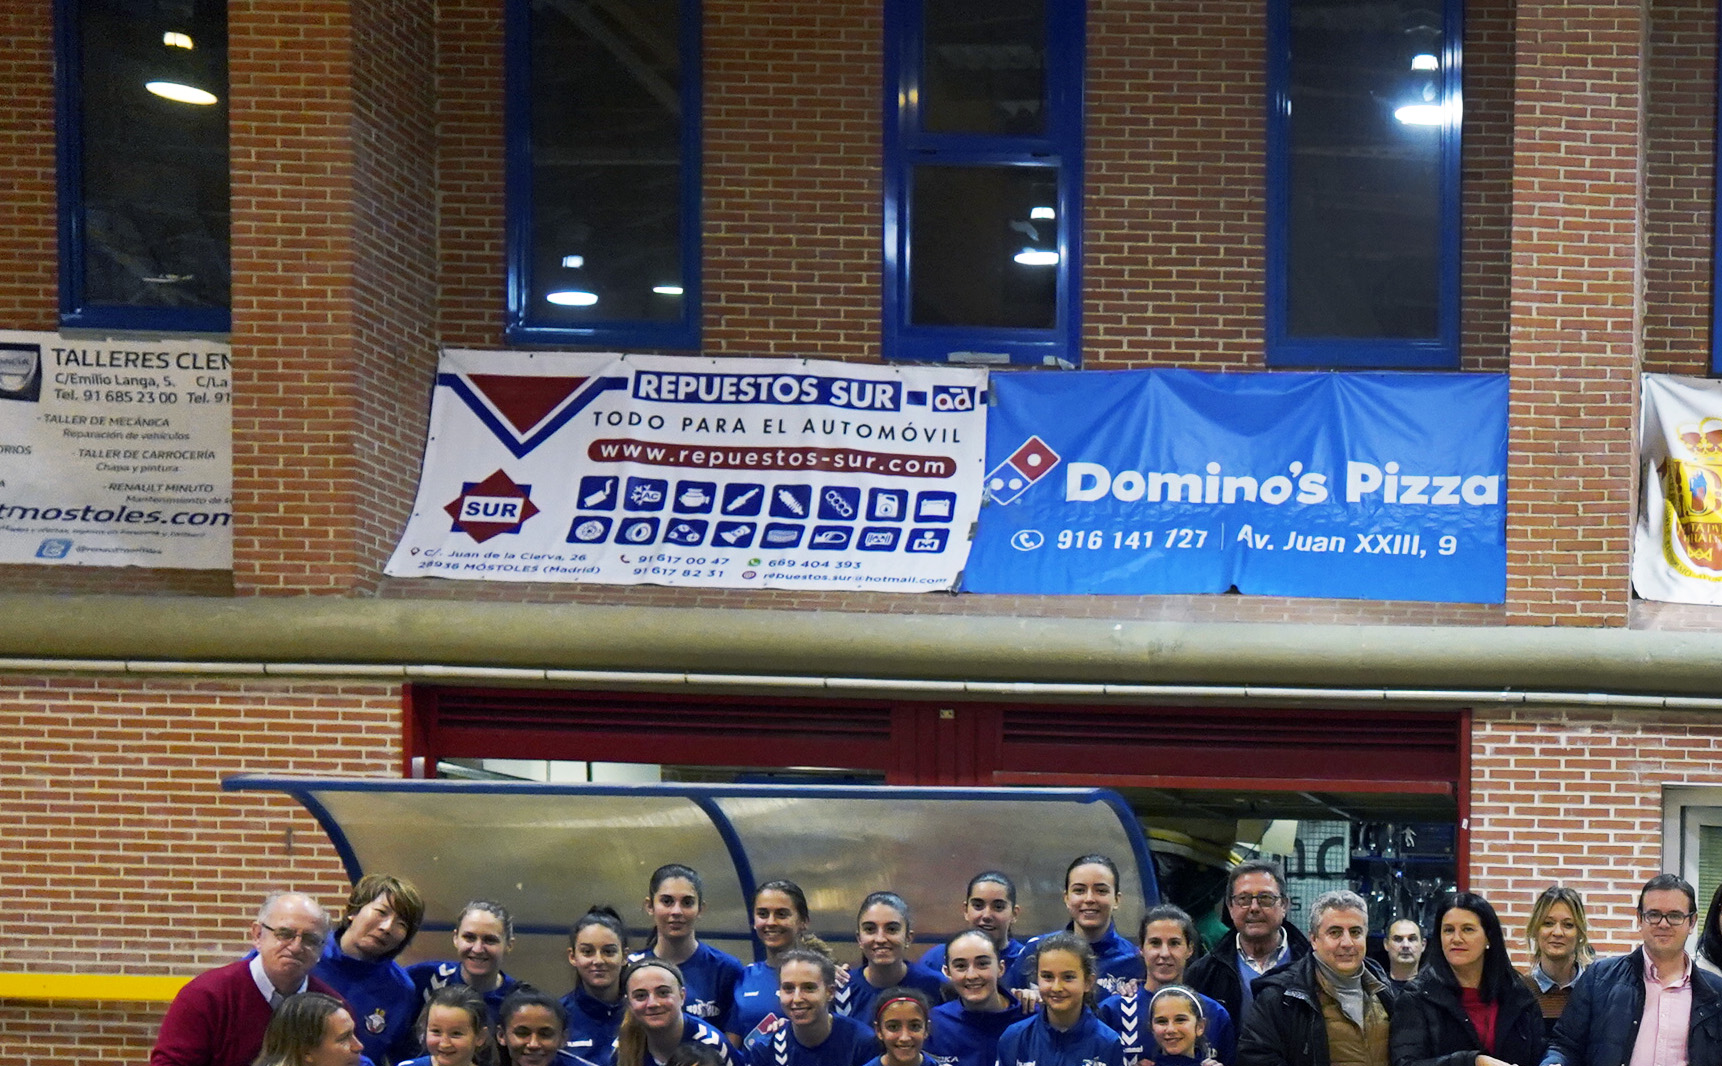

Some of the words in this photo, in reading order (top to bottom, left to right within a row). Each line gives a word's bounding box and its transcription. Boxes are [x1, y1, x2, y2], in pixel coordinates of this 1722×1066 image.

[51, 348, 169, 370] TALLERES
[84, 389, 101, 402] 91
[105, 391, 133, 403] 685
[136, 391, 155, 404] 23
[159, 392, 178, 404] 00
[638, 374, 819, 404] REPUESTOS
[829, 380, 897, 409] SUR
[44, 414, 87, 425] TALLER
[90, 415, 105, 426] DE
[109, 415, 170, 427] MECÁNICA
[594, 411, 665, 431] TODO
[682, 417, 746, 434] PARA
[763, 418, 786, 435] EL
[802, 418, 961, 444] AUTOMÓVIL
[78, 448, 120, 459] TALLER
[600, 441, 946, 476] www.repuestos-sur.com
[1065, 461, 1329, 505] Domino's
[1345, 460, 1499, 506] Pizza
[465, 501, 517, 518] SUR
[1057, 530, 1102, 551] 916
[1113, 531, 1153, 551] 141
[1165, 529, 1208, 549] 727
[1237, 523, 1274, 552] Av.
[1283, 530, 1346, 553] Juan
[1354, 533, 1428, 559] XXIII,
[1438, 535, 1458, 556] 9
[449, 550, 480, 558] Juan
[484, 551, 501, 559] de
[686, 557, 706, 565] 00
[463, 563, 539, 573] MÓSTOLES
[800, 560, 830, 568] 404
